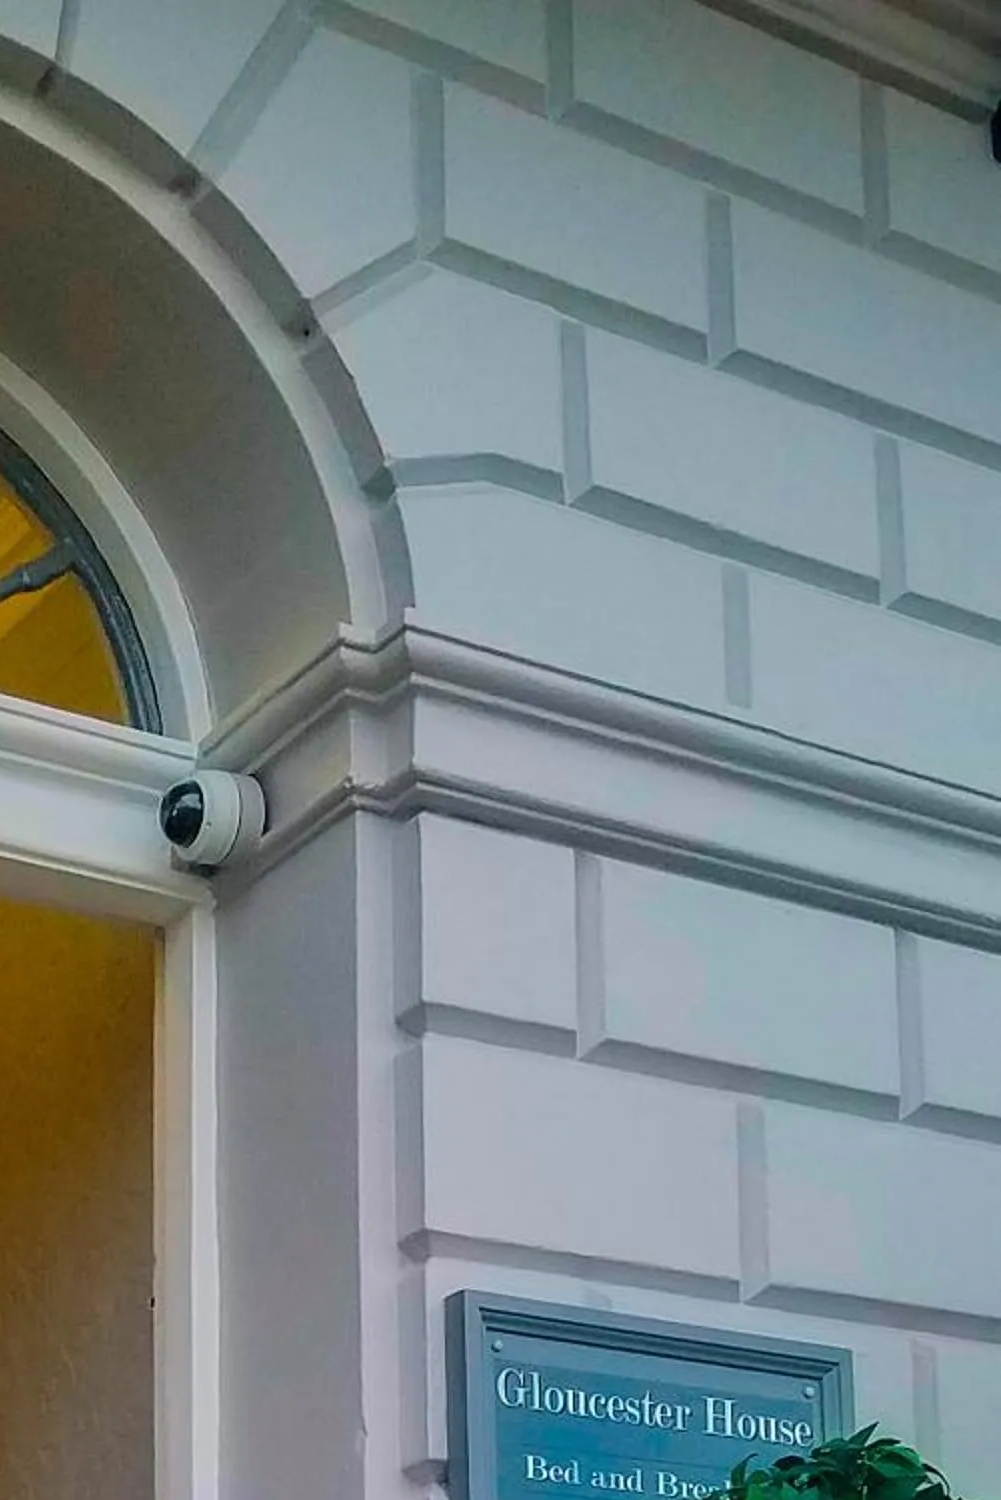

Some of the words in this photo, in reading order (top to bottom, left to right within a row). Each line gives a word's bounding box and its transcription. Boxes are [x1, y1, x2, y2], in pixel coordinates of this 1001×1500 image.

[497, 1367, 691, 1432] Gloucester
[703, 1396, 813, 1447] House
[525, 1455, 581, 1485] Bed
[590, 1468, 644, 1494] and
